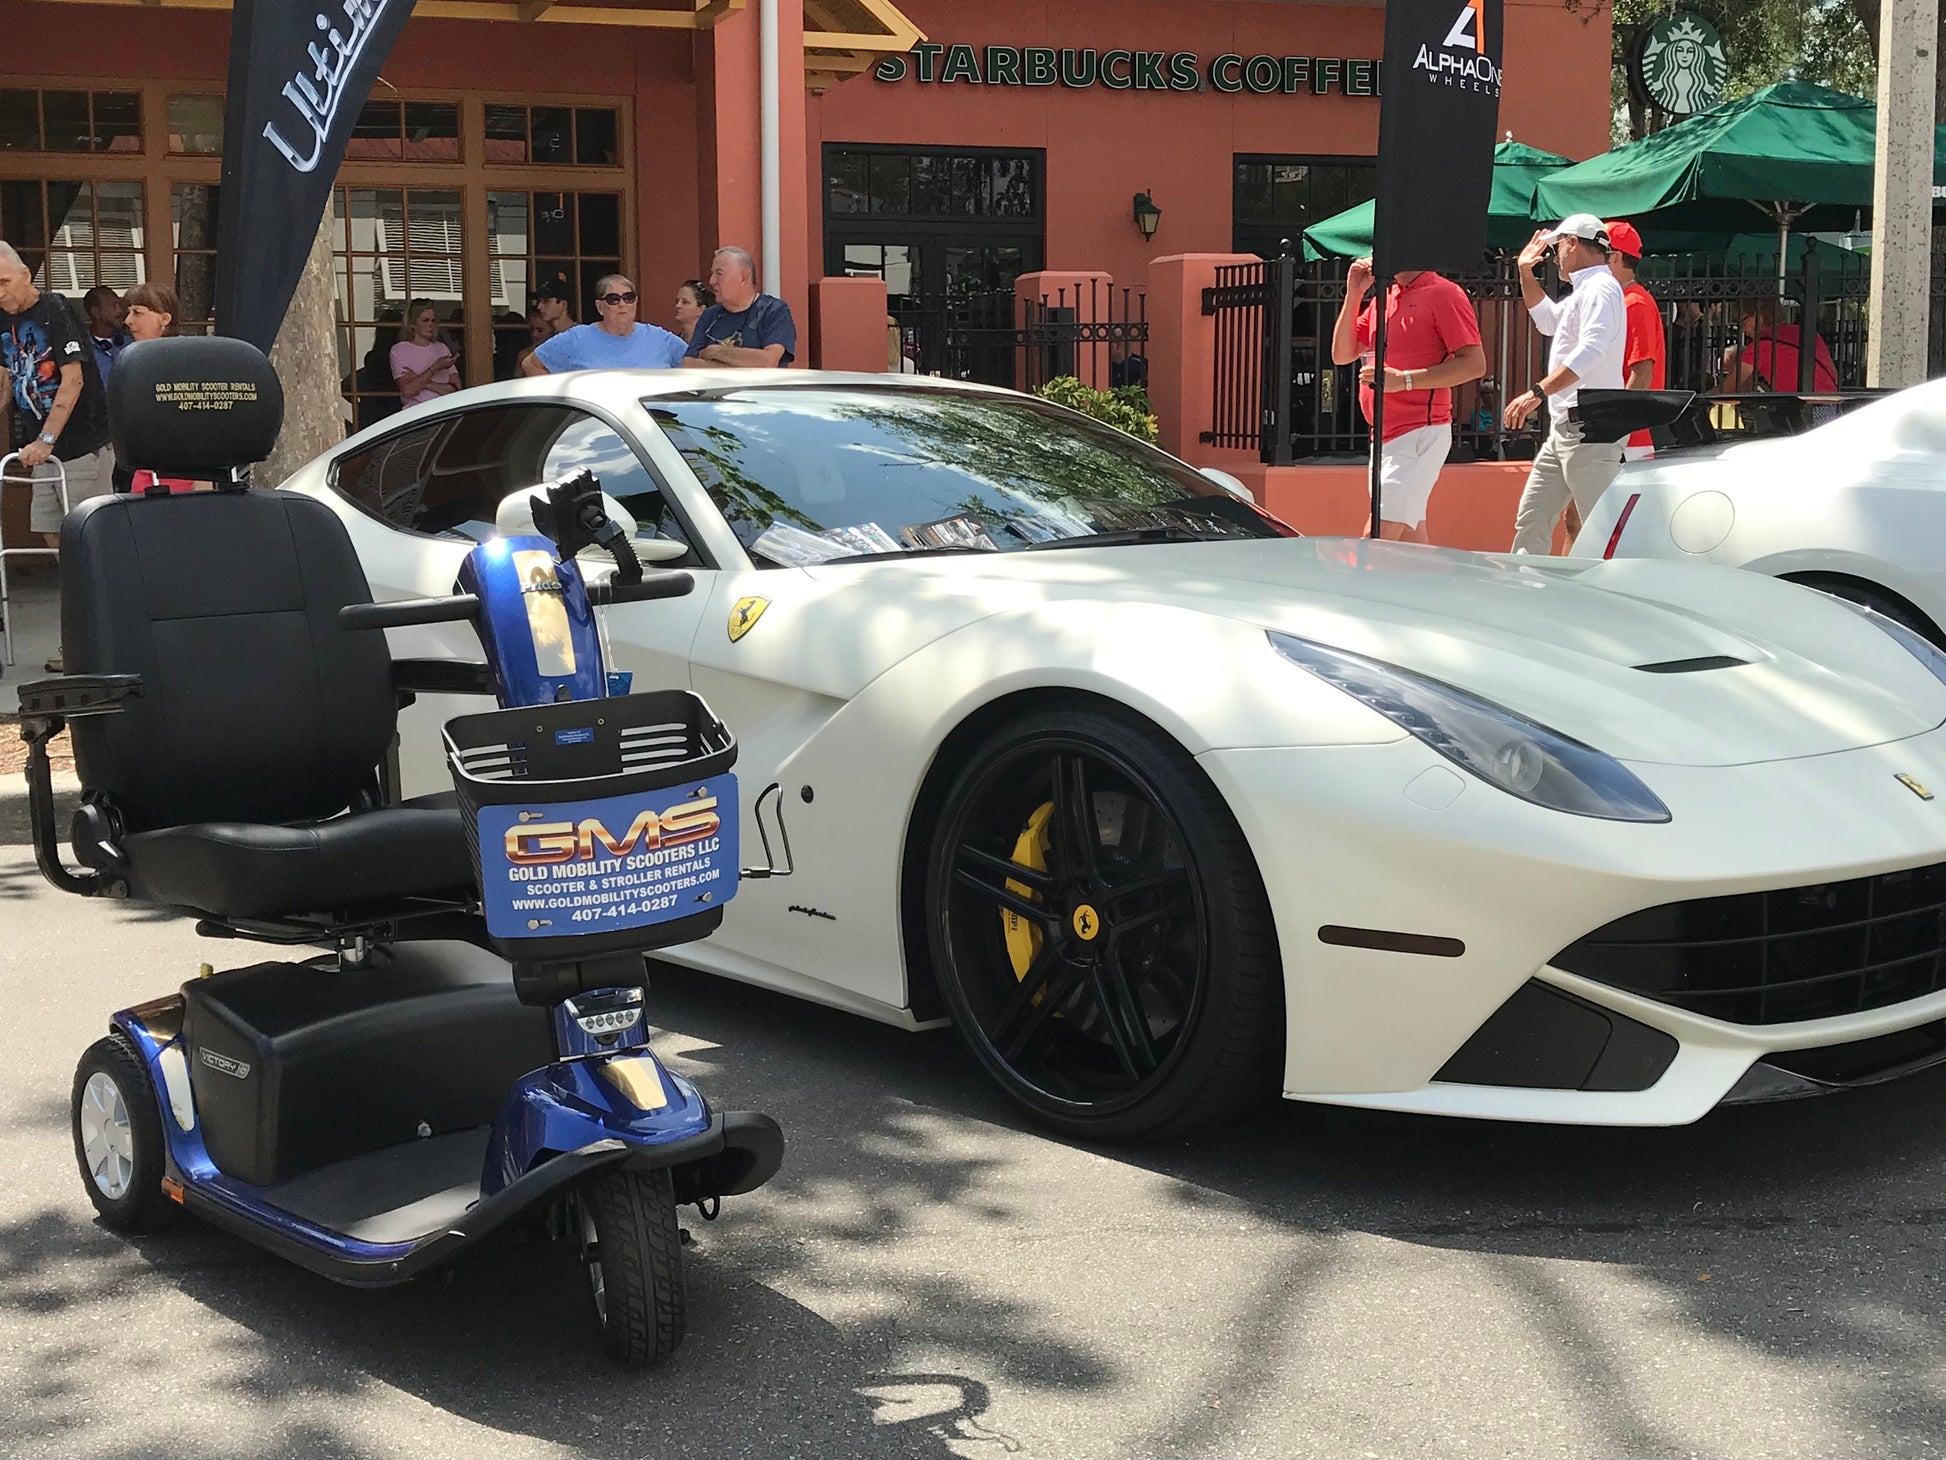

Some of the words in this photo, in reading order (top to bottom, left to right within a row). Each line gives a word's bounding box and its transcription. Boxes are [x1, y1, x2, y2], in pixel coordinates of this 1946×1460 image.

[876, 43, 1199, 91] STARBUCKS
[1212, 53, 1384, 96] COFFE
[1429, 73, 1500, 97] WHEELS
[155, 392, 257, 402] WWW.GOLDMOBILITYSCOOTERS.COM
[156, 383, 171, 392] GOLD
[174, 382, 199, 392] MOBILITY
[201, 382, 228, 391] SCOOTER
[231, 382, 255, 391] RENTALS
[178, 401, 233, 410] 407-414-0287
[504, 796, 721, 866] GMS
[508, 866, 548, 882] GOLD
[552, 858, 623, 879] MOBILITY
[626, 844, 696, 871] SCOOTERS
[698, 837, 720, 855] LLC
[512, 869, 720, 910] WWW.GOLDMOBILITYSCOOTERS.COM
[527, 880, 586, 895] SCOOTER
[589, 879, 598, 891] &
[602, 870, 662, 889] STROLLER
[664, 857, 711, 877] RENTALS
[571, 894, 678, 922] 407-414-0287
[202, 1051, 237, 1072] VICTORY
